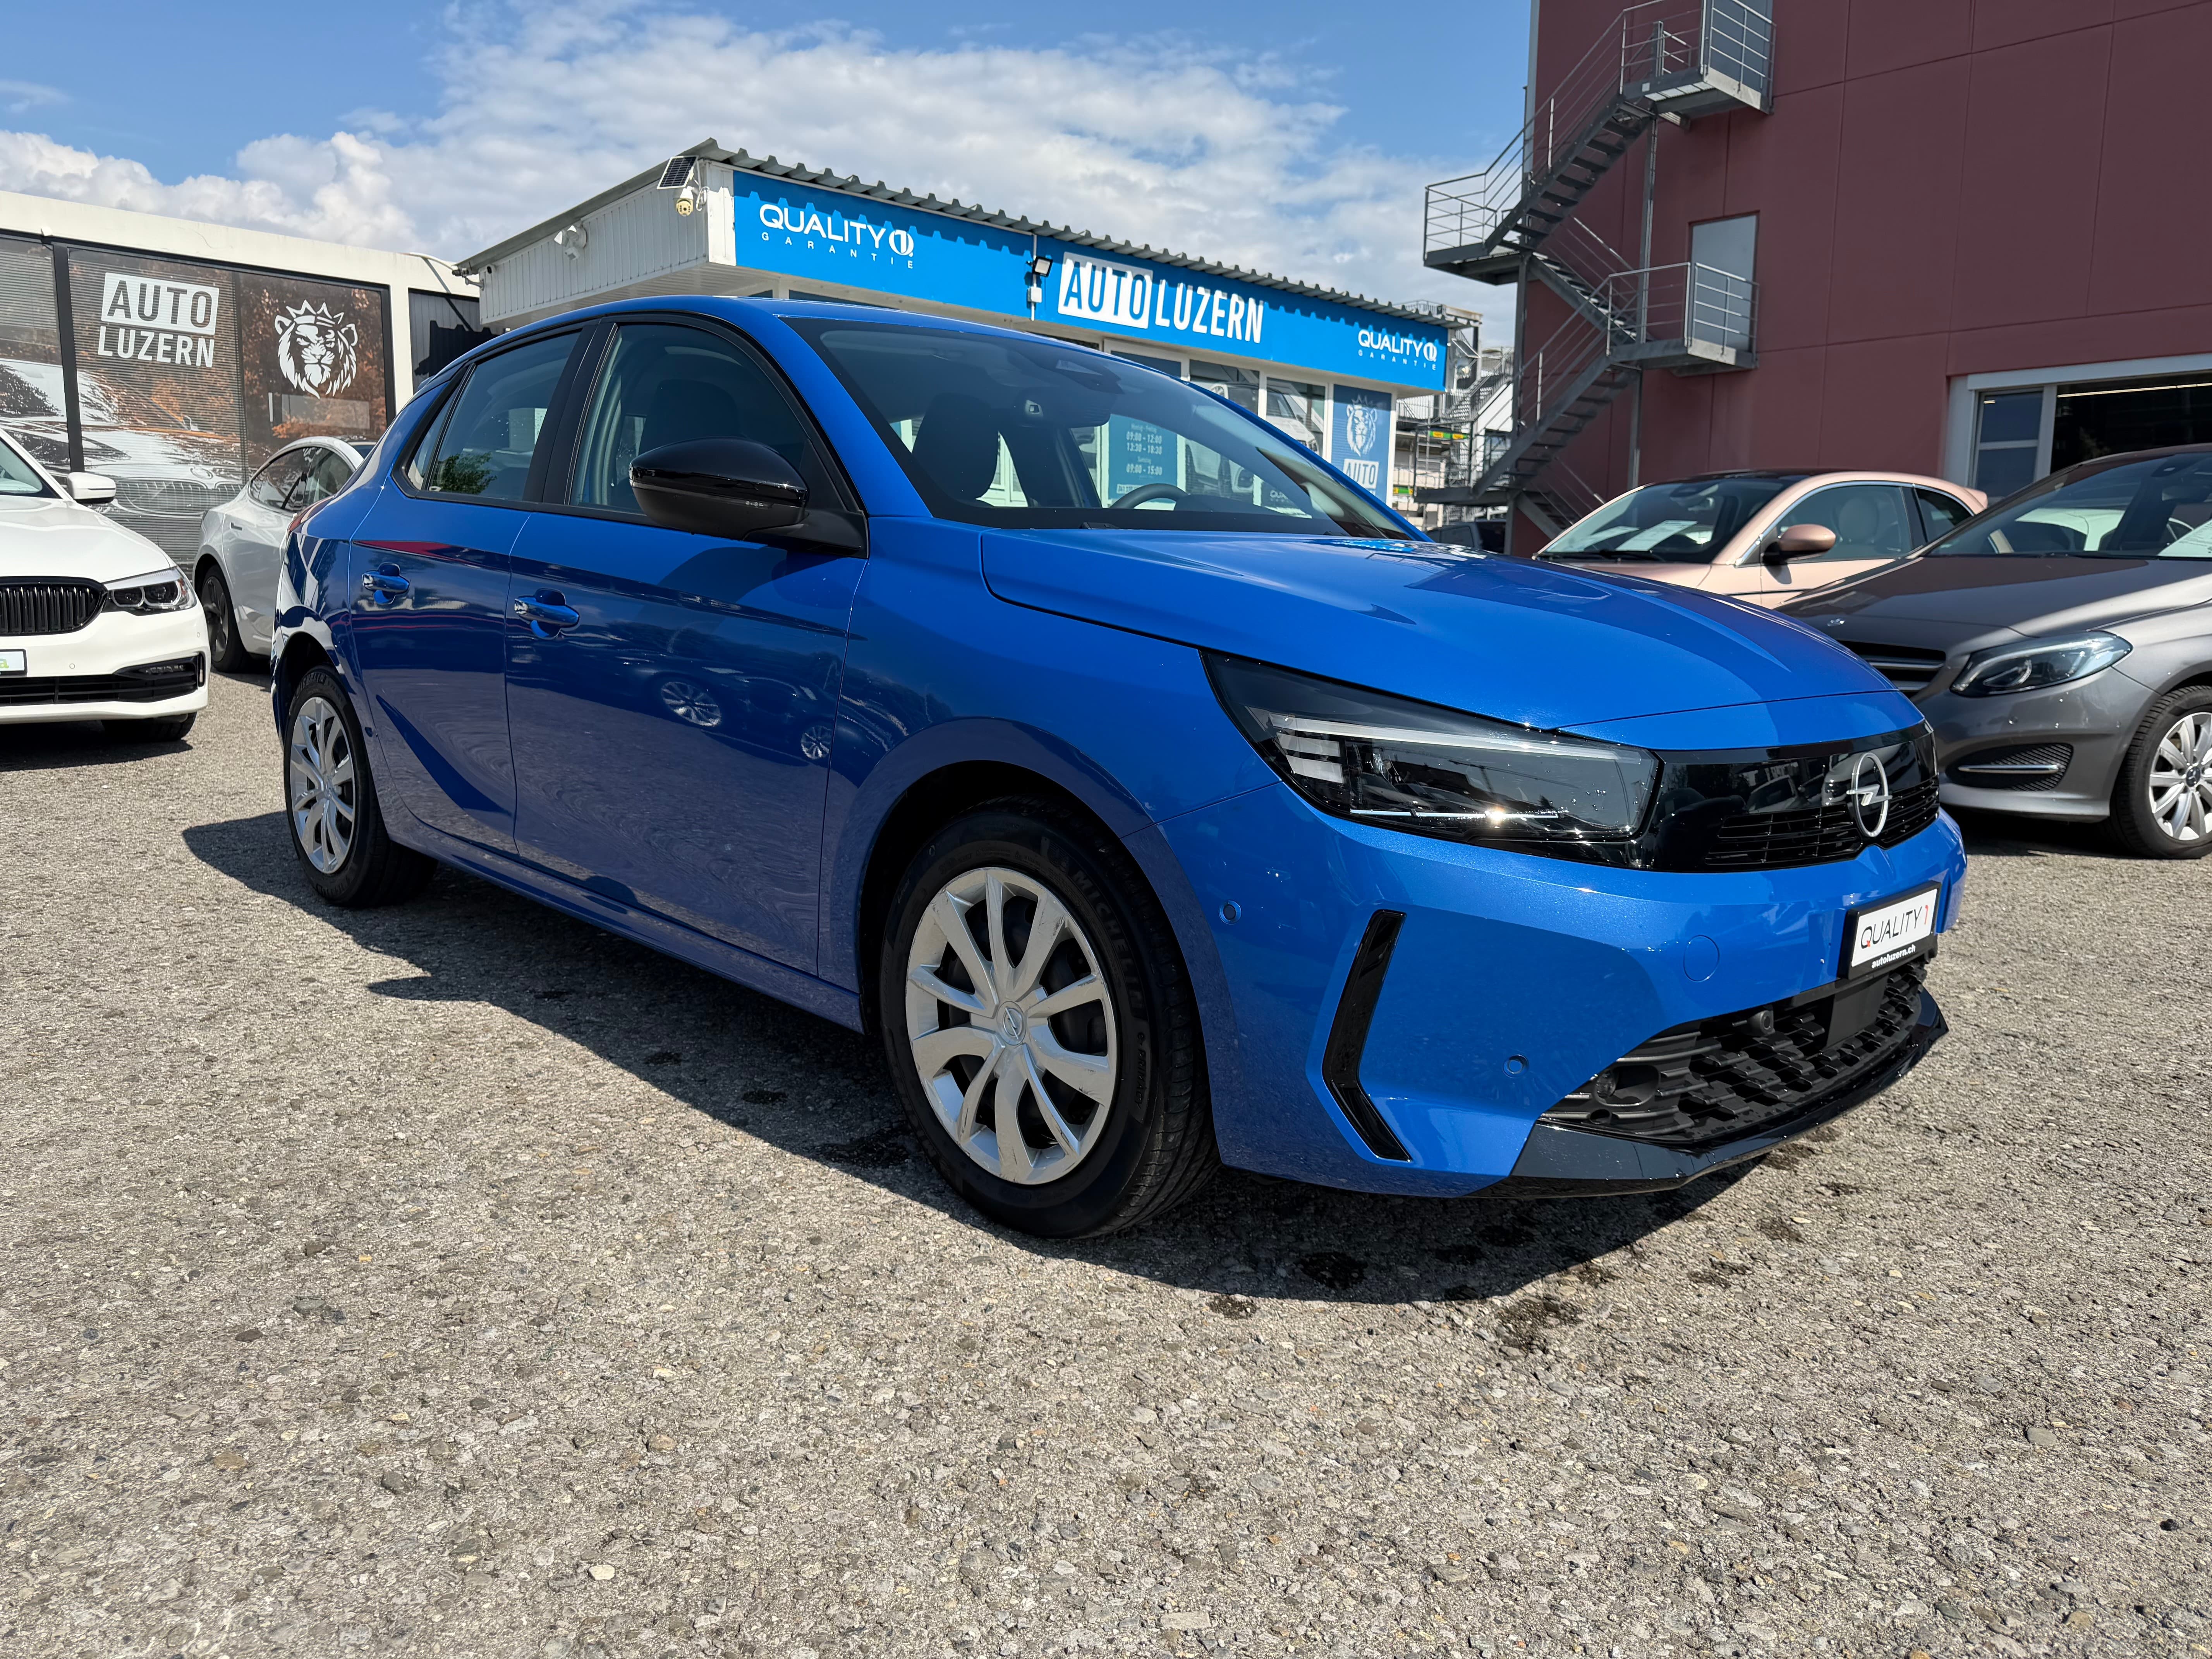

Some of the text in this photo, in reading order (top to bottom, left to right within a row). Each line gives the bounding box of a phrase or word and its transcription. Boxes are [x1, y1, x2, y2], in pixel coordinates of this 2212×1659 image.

[759, 204, 886, 248] QUALITY
[761, 232, 914, 269] GARANTIE
[107, 280, 213, 328] AUTO
[1064, 261, 1264, 344] AUTO LUZERN
[97, 325, 215, 368] LUZERN
[1358, 329, 1423, 357] QUALITY
[1358, 349, 1436, 371] GARANTIE
[1346, 462, 1376, 484] AUTO
[1072, 870, 1145, 1009] MICHELIN
[1861, 906, 1922, 949] QUALITY
[1871, 944, 1916, 969] autoluzern.ch
